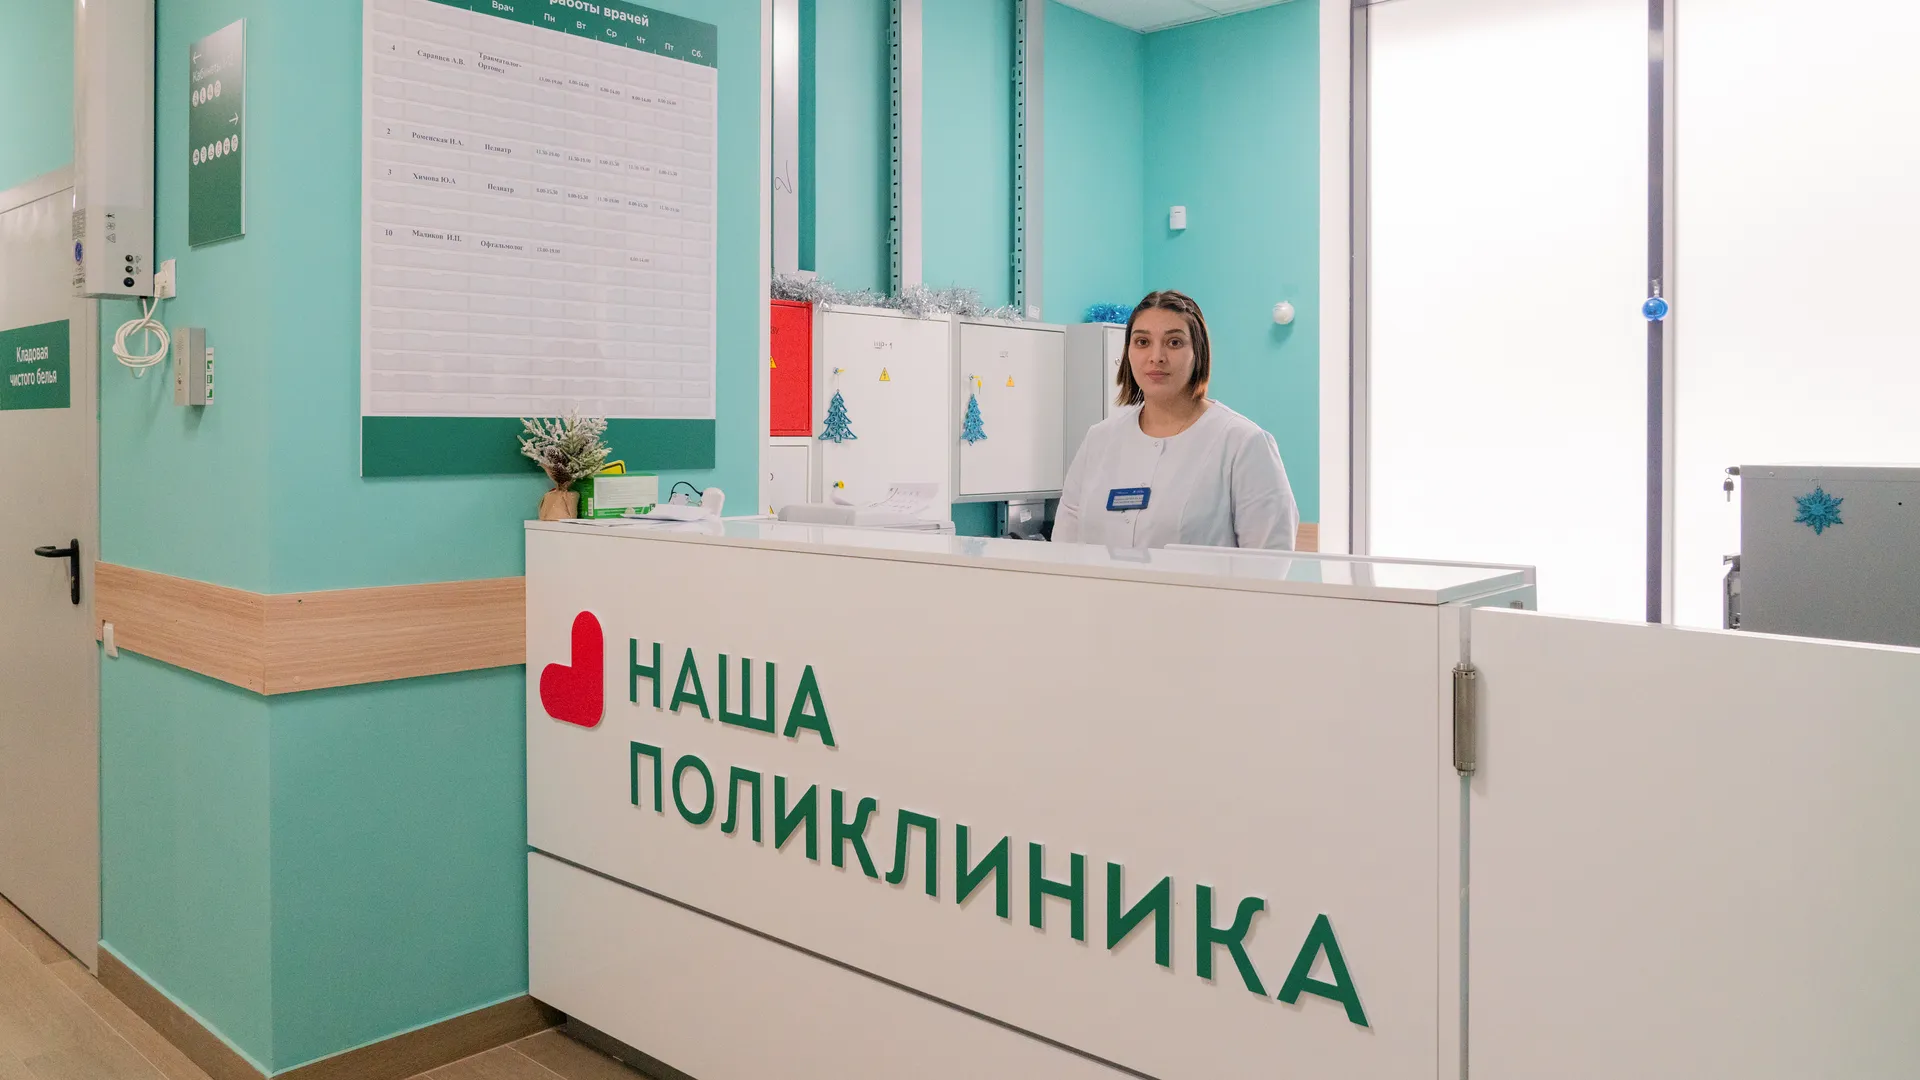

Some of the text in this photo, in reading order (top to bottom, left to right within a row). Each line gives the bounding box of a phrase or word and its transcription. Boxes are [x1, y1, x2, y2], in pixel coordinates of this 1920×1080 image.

[603, 7, 650, 27] врачей
[492, 0, 703, 59] Врач Пн Вт Ср Чт Пт Сб.
[478, 51, 522, 68] Травматолог-
[478, 61, 505, 74] Ортопед
[386, 127, 391, 135] 2
[484, 143, 512, 154] Педиатр
[387, 168, 392, 176] 3
[487, 183, 515, 194] Педиатр
[480, 240, 524, 251] Офтальмолог
[16, 346, 49, 364] Кладовая
[10, 368, 57, 387] чистого белья
[629, 638, 837, 748] НАША
[629, 740, 1371, 1028] ПОЛИКЛИНИКА
